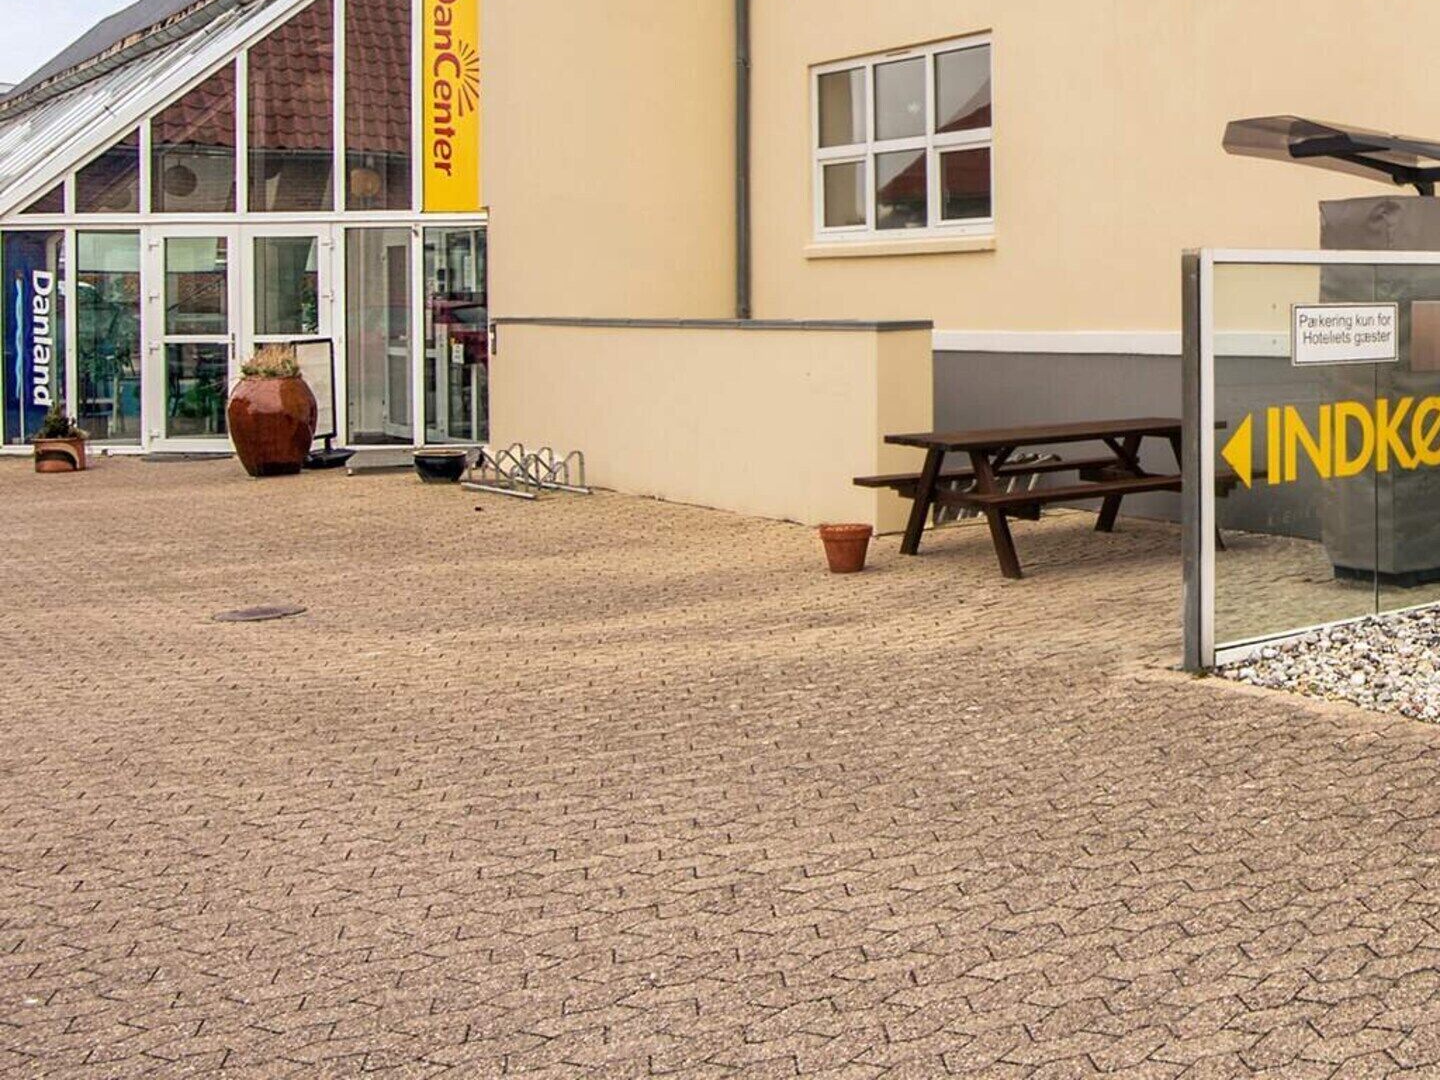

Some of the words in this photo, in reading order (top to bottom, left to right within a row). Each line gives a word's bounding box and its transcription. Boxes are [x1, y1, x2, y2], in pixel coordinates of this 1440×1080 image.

[1355, 313, 1375, 326] kun
[1377, 312, 1392, 326] for
[32, 270, 54, 406] Danland
[1354, 329, 1392, 347] gæster
